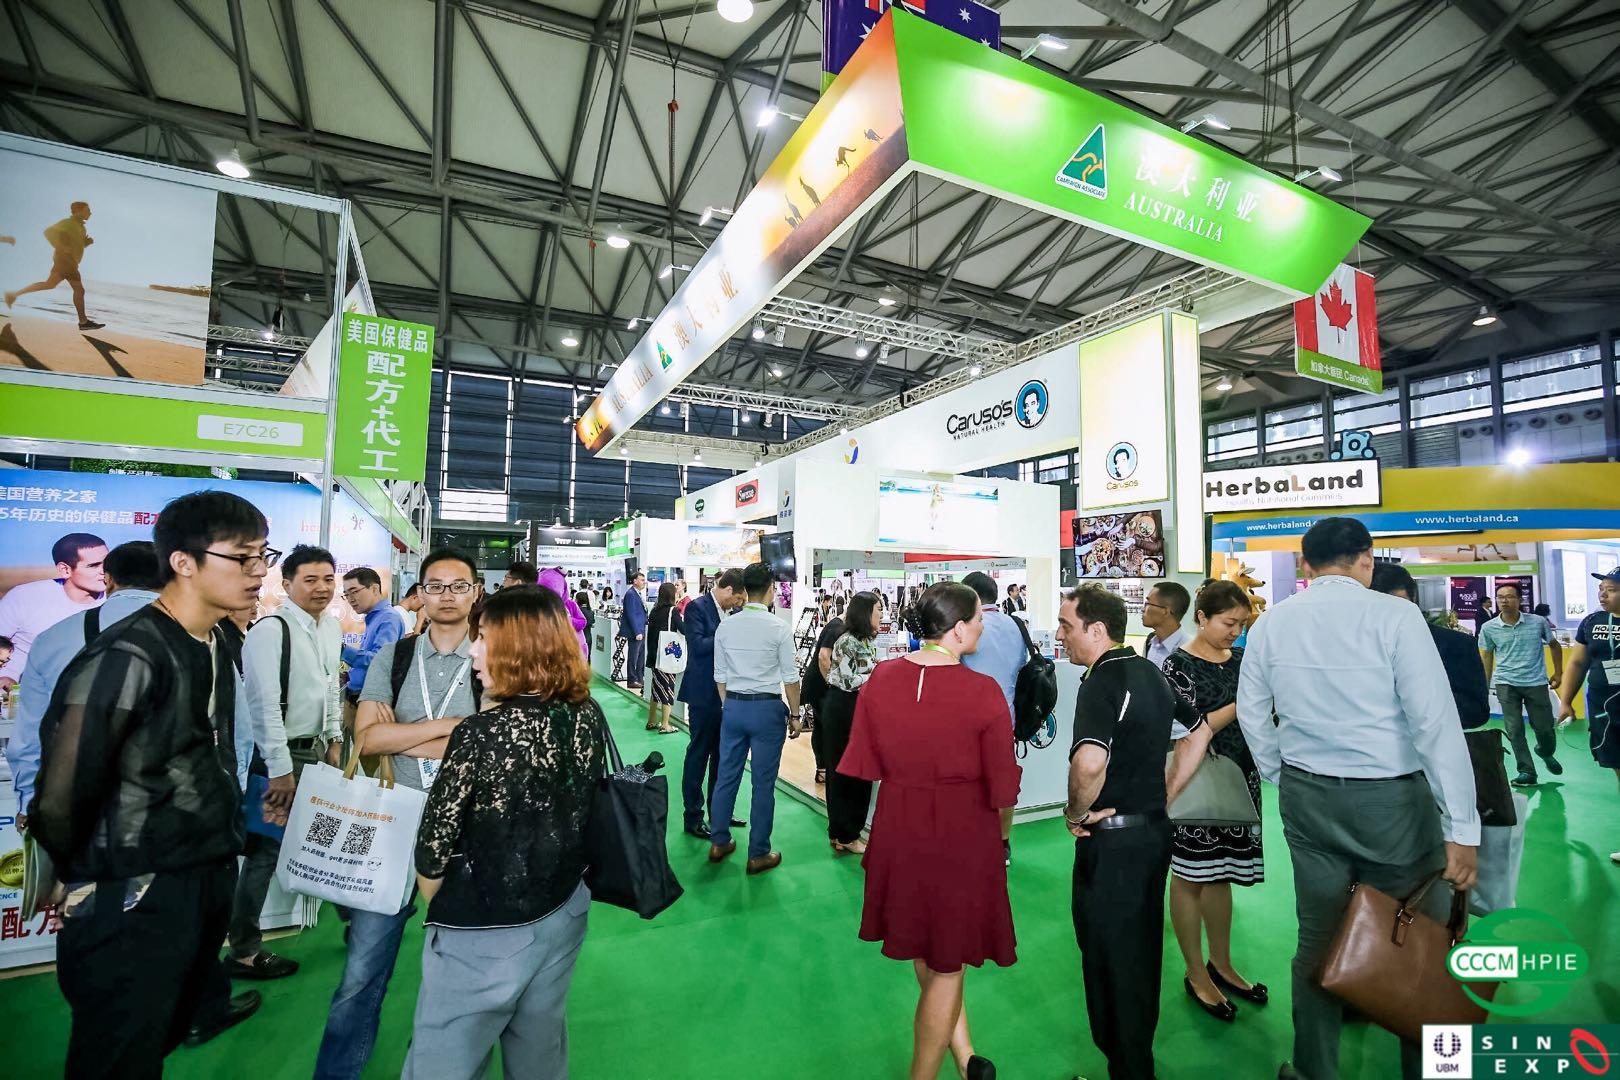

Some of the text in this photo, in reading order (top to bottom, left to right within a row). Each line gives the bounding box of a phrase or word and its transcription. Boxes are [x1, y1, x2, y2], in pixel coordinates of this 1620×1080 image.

[1123, 192, 1223, 243] AUSTRALIA
[347, 318, 428, 353] 美国保健品
[1344, 371, 1370, 386] Canada
[946, 400, 1013, 434] Caruso's
[223, 422, 279, 438] E7C26
[953, 420, 1005, 440] NATURAL HEALTH
[1205, 468, 1363, 498] HerbaLand
[1415, 514, 1519, 524] www.herbaland.ca
